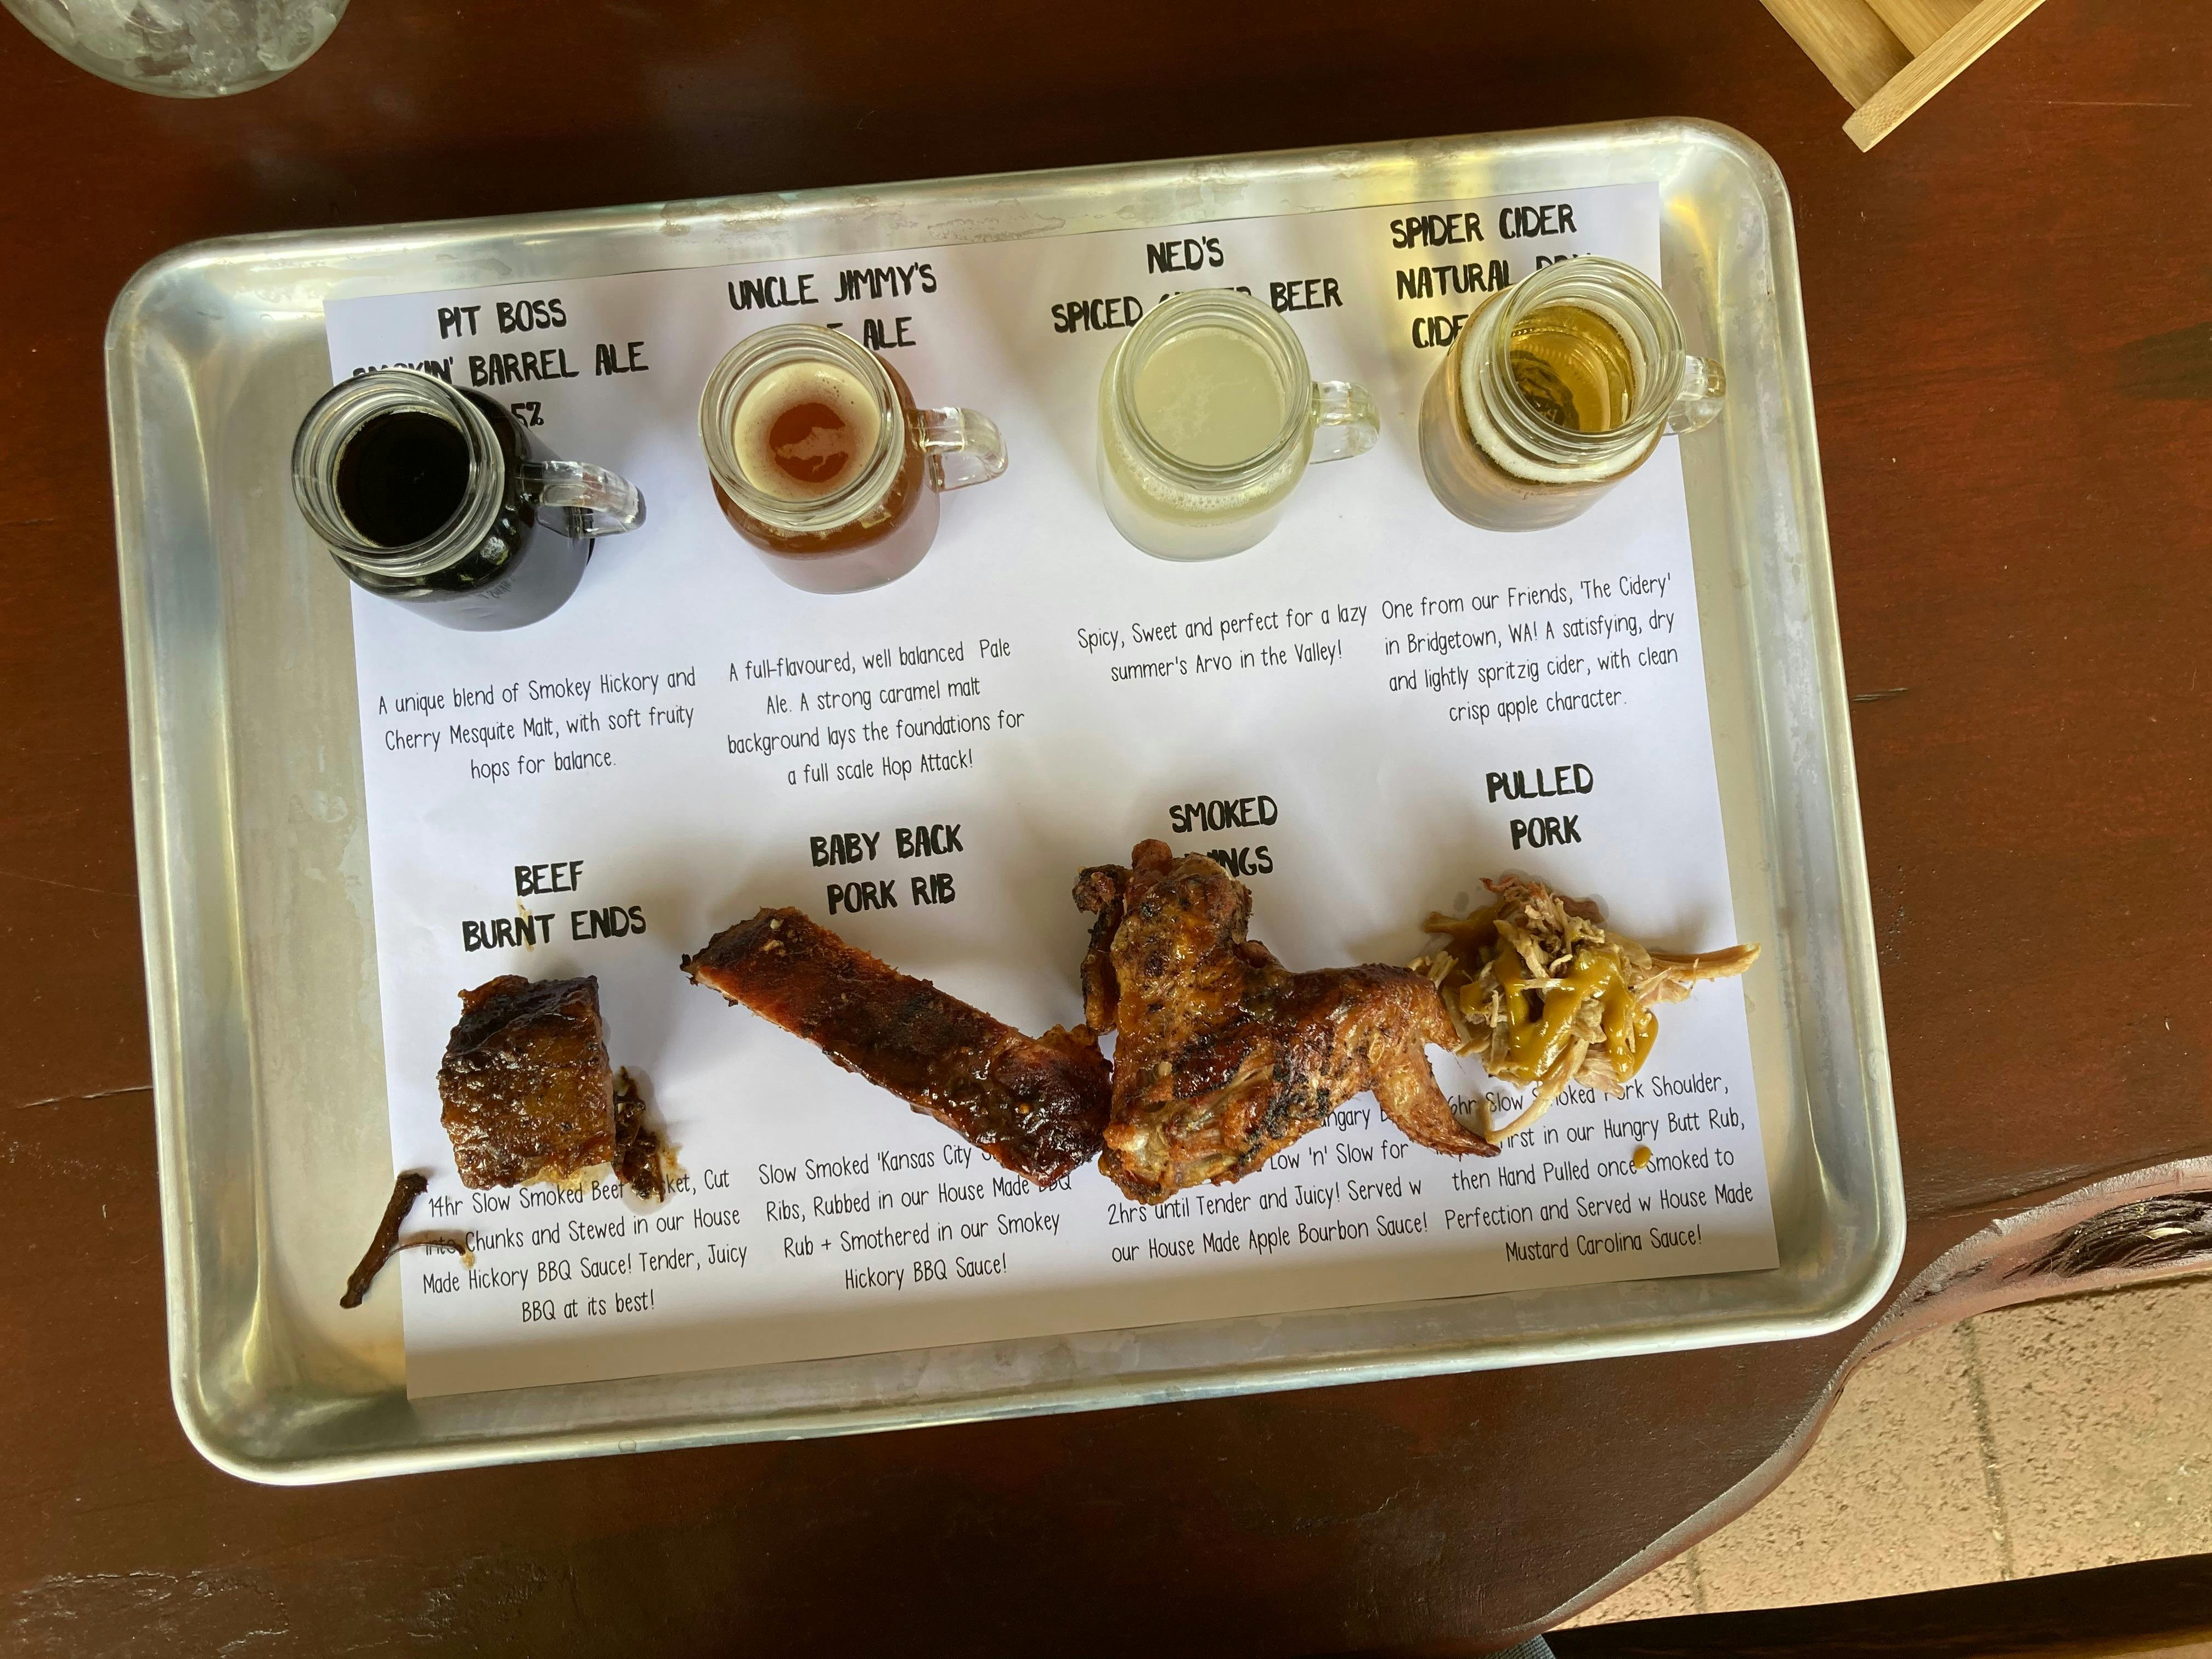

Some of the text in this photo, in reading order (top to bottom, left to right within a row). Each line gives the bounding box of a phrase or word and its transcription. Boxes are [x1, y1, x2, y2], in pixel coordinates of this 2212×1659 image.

[1390, 204, 1577, 249] SPIDER CIDER
[1147, 236, 1224, 274] NED'S
[728, 262, 936, 311] UNCLE JIMMY'S
[1396, 259, 1513, 300] NATURAL
[437, 298, 567, 339] PIT BOSS
[1051, 296, 1143, 333] SPICED
[1269, 278, 1343, 313] BEER
[863, 317, 916, 350] ALE
[1412, 314, 1469, 348] CIDE
[469, 349, 579, 387] BARREL
[596, 342, 648, 376] ALE
[1382, 572, 1670, 619] One from our Friends, 'The Cidery'
[1078, 604, 1367, 654] Spicy, Sweet and perfect for a lazy
[1385, 609, 1674, 655] in Bridgetown, WA! A satisfying, dry
[730, 638, 1011, 681] A full-flavoured, well balanced Pale
[1111, 639, 1341, 681] summer's Arvo in the Valley!
[379, 666, 695, 716] A unique blend of Smokey Hickory and
[768, 677, 980, 714] Ale. A strong caramel malt
[1449, 689, 1626, 725] crisp apple character.
[728, 710, 1024, 756] background lays the foundations for
[471, 751, 616, 783] hops for balance.
[1486, 764, 1593, 803] PULLED
[1169, 795, 1278, 833] SMOKED
[1510, 815, 1581, 850] PORK
[810, 824, 963, 867] BABY BACK
[1184, 845, 1273, 877] INGS
[515, 860, 584, 896] BEEF
[827, 873, 955, 915] PORK RIB
[462, 906, 646, 952] BURNT ENDS
[1486, 1072, 1728, 1113] Slow Shoulder,
[1321, 1109, 1370, 1131] ngary
[1543, 1126, 1559, 1144] in
[1567, 1126, 1594, 1142] our
[1604, 1119, 1658, 1142] Hungry
[1668, 1112, 1700, 1133] Butt
[1709, 1107, 1744, 1130] Rub,
[759, 1144, 972, 1184] Slow Smoked 'Kansas City
[1271, 1139, 1408, 1170] Low 'n' Slow for
[1452, 1170, 1490, 1191] then
[1498, 1164, 1536, 1187] Hand
[1543, 1159, 1589, 1182] Pulled
[1598, 1160, 1637, 1177] once
[1714, 1148, 1734, 1166] to
[428, 1195, 463, 1217] 14hr
[472, 1192, 510, 1213] Slow
[519, 1184, 583, 1209] Smoked
[704, 1169, 730, 1189] Cut
[767, 1200, 805, 1222] Ribs,
[814, 1191, 870, 1217] Rubbed
[879, 1194, 893, 1210] in
[901, 1190, 929, 1207] our
[939, 1183, 984, 1203] House
[993, 1175, 1029, 1197] Made
[1108, 1176, 1421, 1225] 2hrs until Tender and Juicy! Served w
[1444, 1182, 1753, 1229] Perfection and Served w House Made
[465, 1229, 524, 1252] Chunks
[532, 1222, 560, 1246] and
[568, 1216, 625, 1242] Stewed
[634, 1216, 648, 1234] in
[657, 1216, 684, 1232] our
[694, 1208, 740, 1228] House
[1112, 1211, 1427, 1262] our House Made Apple Bourbon Sauce!
[1506, 1224, 1701, 1262] Mustard Carolina Sauce!
[424, 1244, 747, 1294] Made Hickory BBQ Sauce! Tender, Juicy
[522, 1289, 654, 1322] BBQ at its best!
